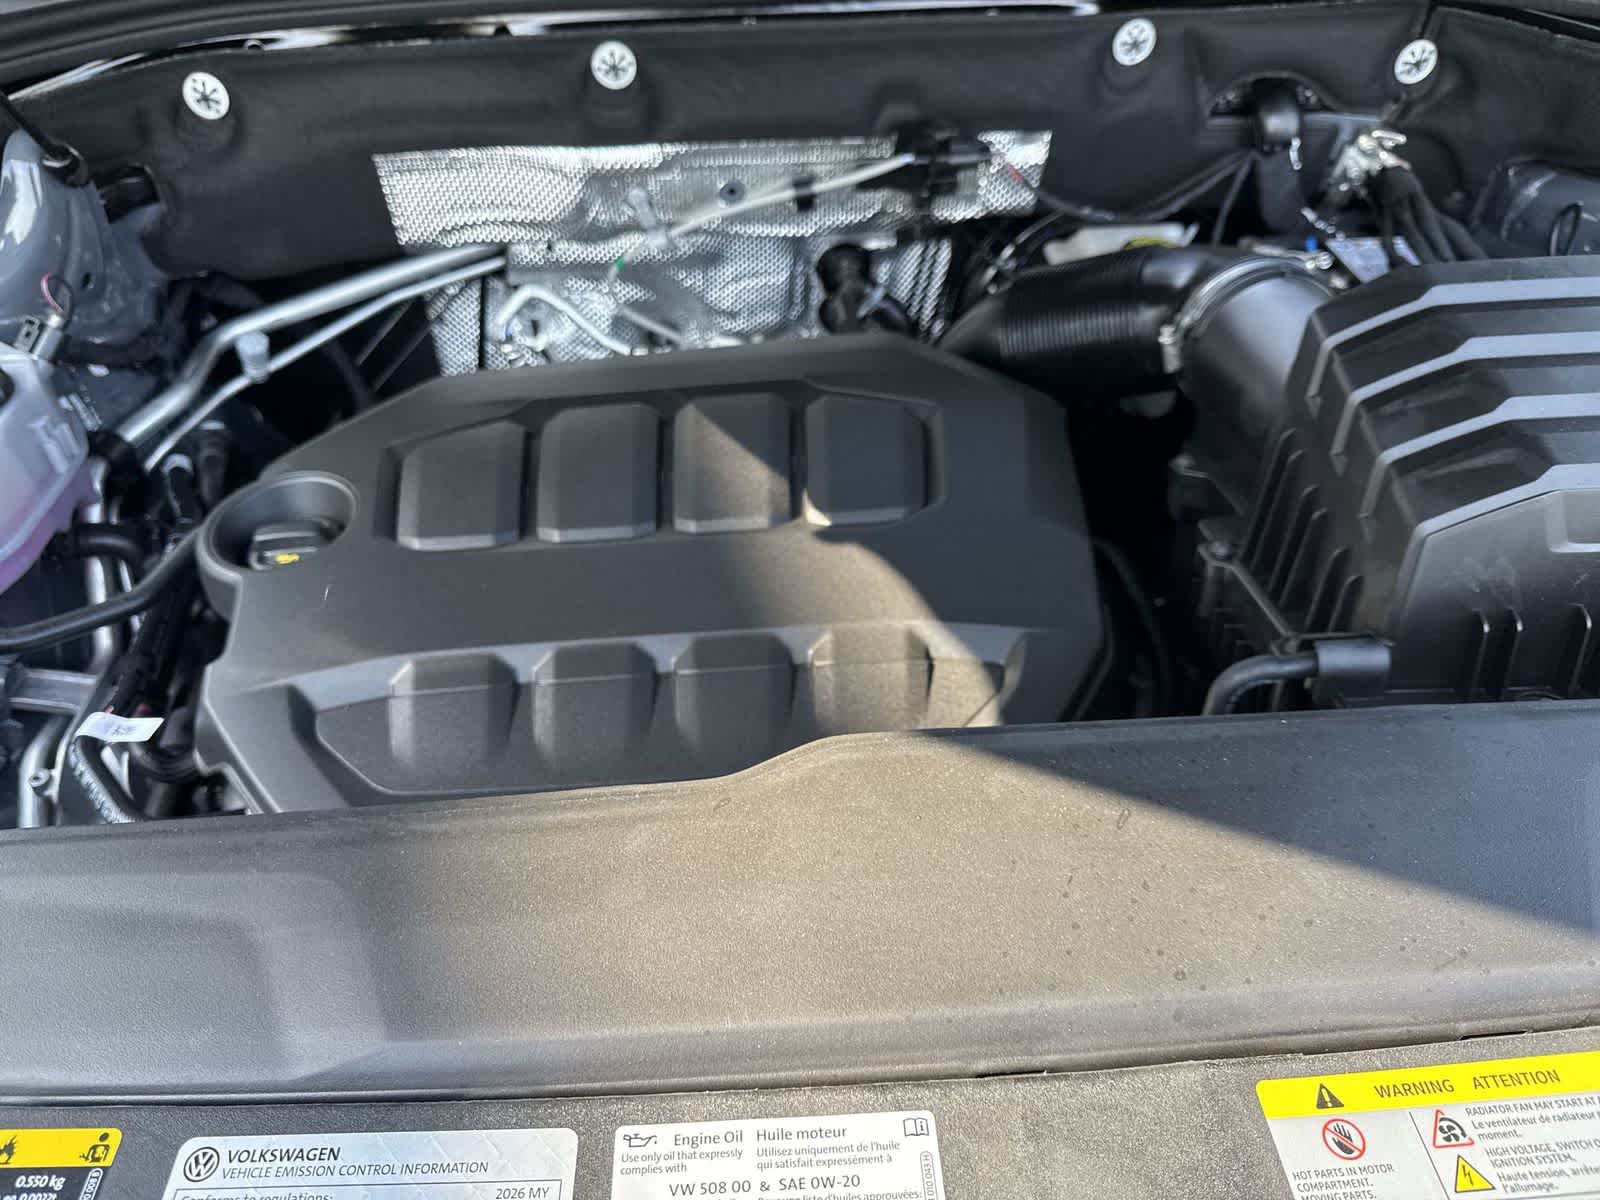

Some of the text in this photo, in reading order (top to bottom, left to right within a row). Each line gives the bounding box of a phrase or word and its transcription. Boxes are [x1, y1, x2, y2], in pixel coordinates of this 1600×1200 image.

[1374, 1070, 1561, 1099] WARNING ATTENTION
[1465, 1103, 1513, 1117] RADIATOR
[1513, 1102, 1533, 1112] FAN
[1534, 1100, 1554, 1110] MAY
[1554, 1098, 1584, 1109] START
[1584, 1096, 1596, 1106] AT
[1471, 1119, 1485, 1130] Le
[1485, 1116, 1538, 1129] ventilateur
[1538, 1114, 1550, 1124] de
[1552, 1111, 1596, 1122] radiateur
[674, 1130, 743, 1149] Engine Oil
[756, 1126, 847, 1141] Huile moteur
[228, 1147, 341, 1163] VOLKSWAGEN
[621, 1148, 743, 1164] Use only oil that expressly
[756, 1140, 901, 1160] Utilisez uniquement de l'huile
[1485, 1146, 1511, 1158] HIGH
[1556, 1139, 1594, 1150] SWITCH
[223, 1161, 488, 1179] VEHICLE EMISSION CONTROL INFORMATION
[620, 1163, 687, 1176] complies with
[756, 1152, 893, 1172] qui satisfait expressément à
[1490, 1156, 1536, 1168] IGNITION
[1292, 1163, 1395, 1181] HOT PARTS IN MOTOR
[1497, 1171, 1529, 1182] Haute
[15, 1174, 66, 1191] 0.550 kg
[669, 1174, 861, 1196] VW 508 00 & SAE 0W-20
[496, 1187, 550, 1199] 2026 MY
